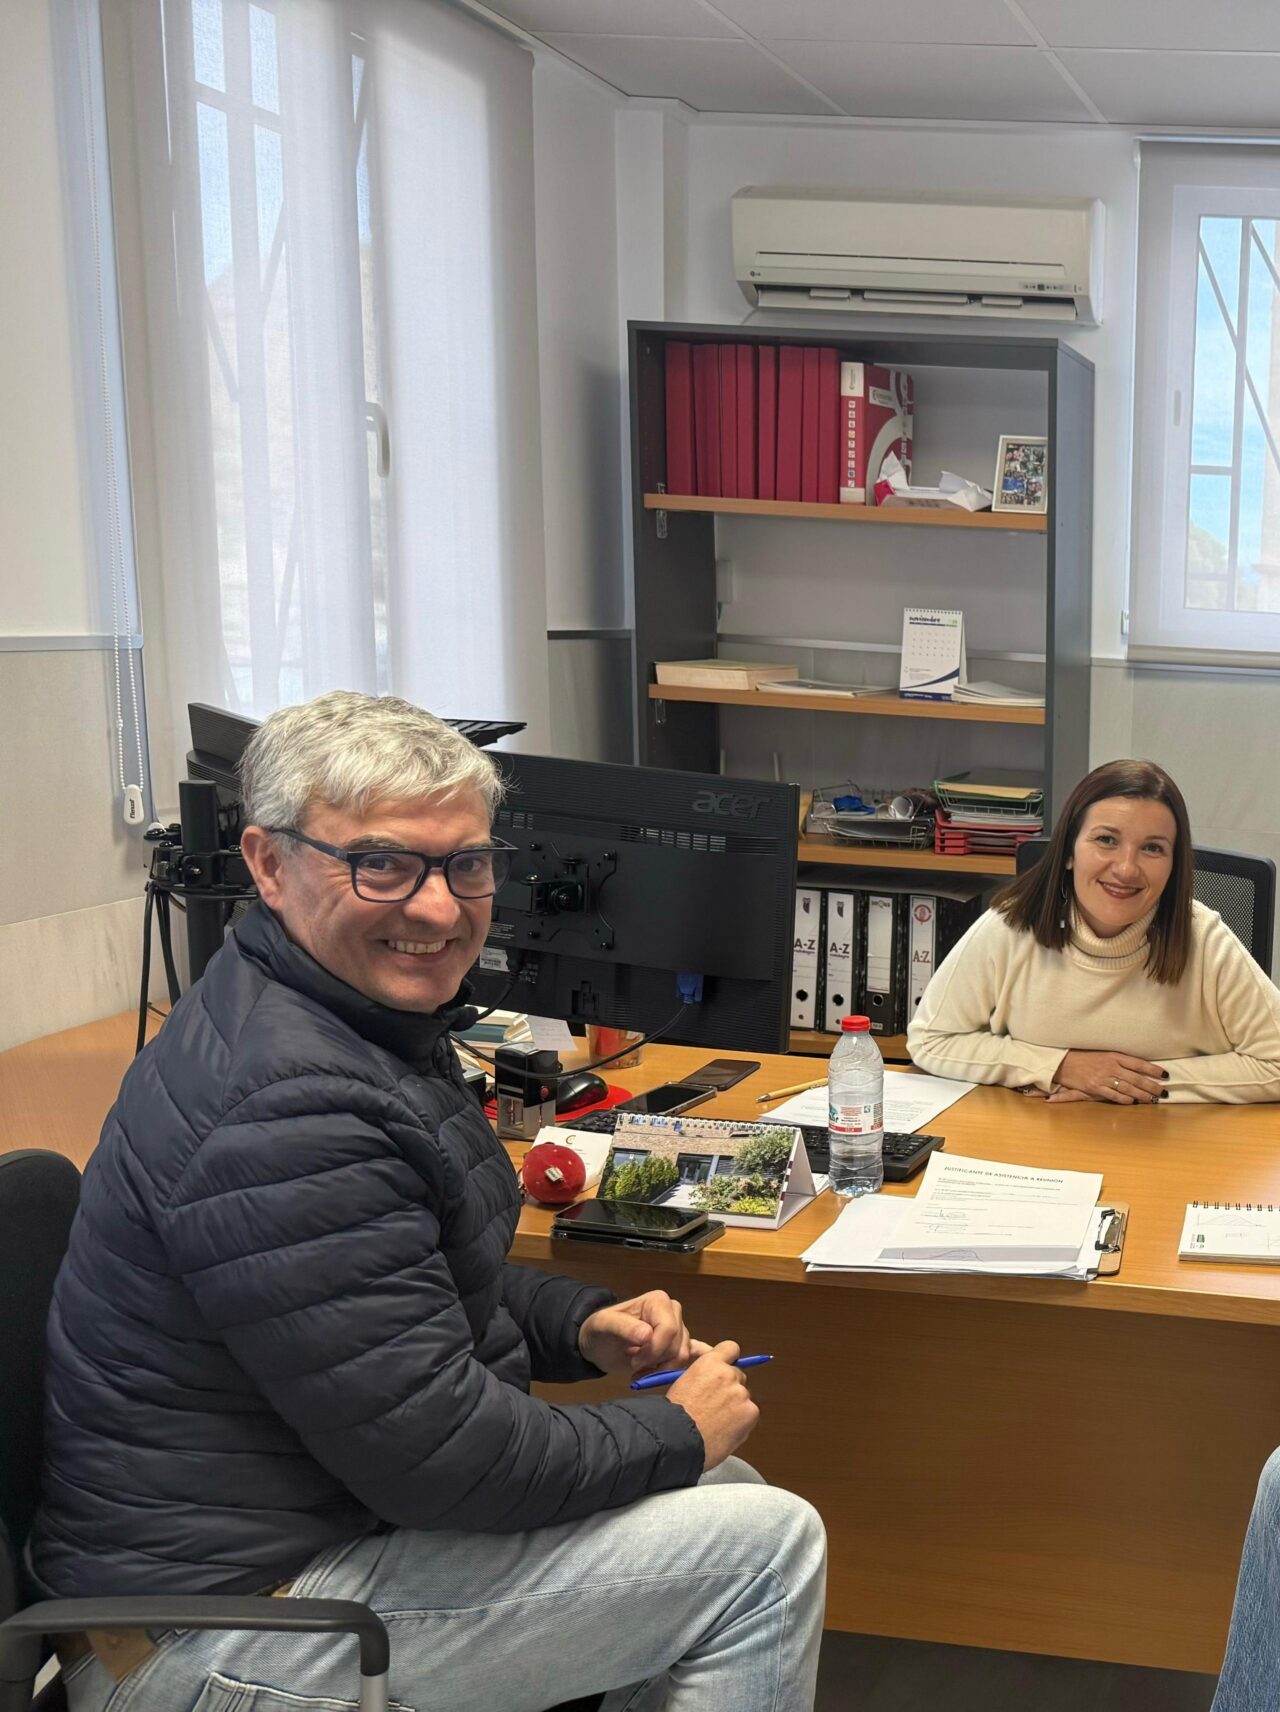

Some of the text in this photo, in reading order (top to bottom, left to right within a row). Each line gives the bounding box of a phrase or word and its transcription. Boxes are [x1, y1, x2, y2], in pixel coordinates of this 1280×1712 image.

[692, 790, 770, 819] acer
[794, 938, 815, 950] A-Z
[829, 942, 850, 954] A-Z
